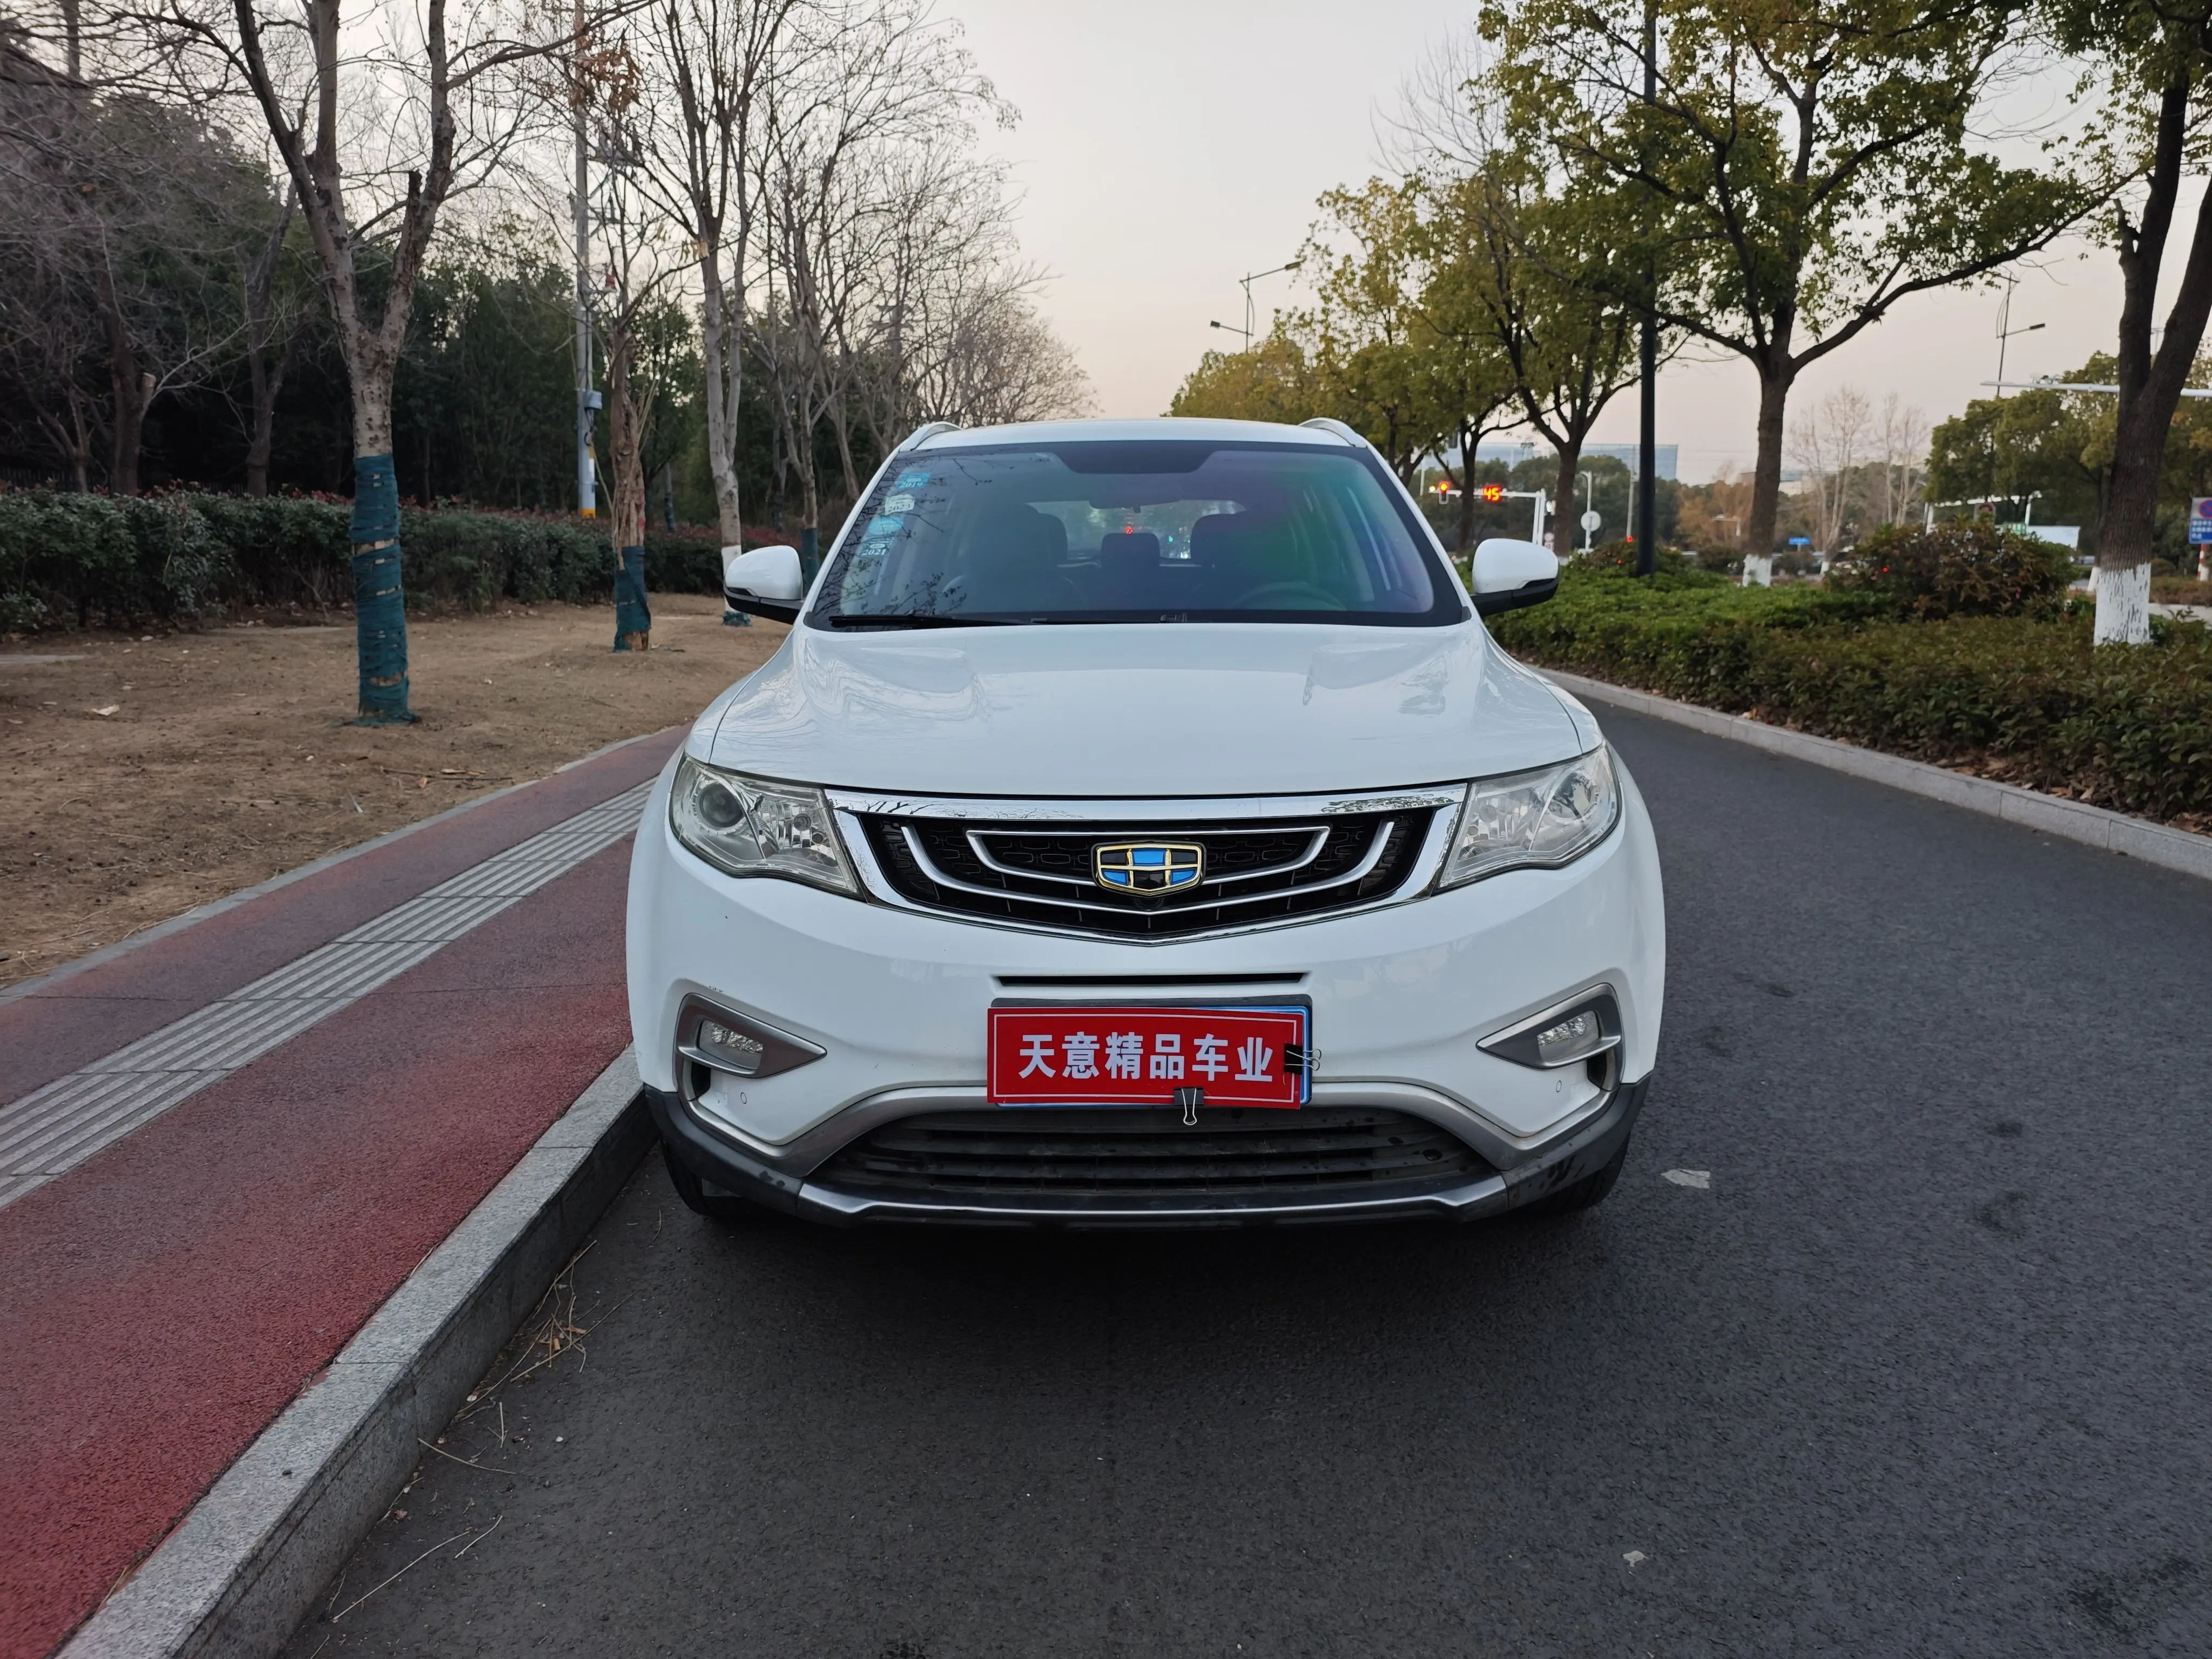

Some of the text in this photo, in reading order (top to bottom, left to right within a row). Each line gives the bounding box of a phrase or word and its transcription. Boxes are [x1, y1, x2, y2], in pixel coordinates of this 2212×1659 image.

[1483, 487, 1500, 501] 45
[1019, 1031, 1273, 1082] 天意精品车业
